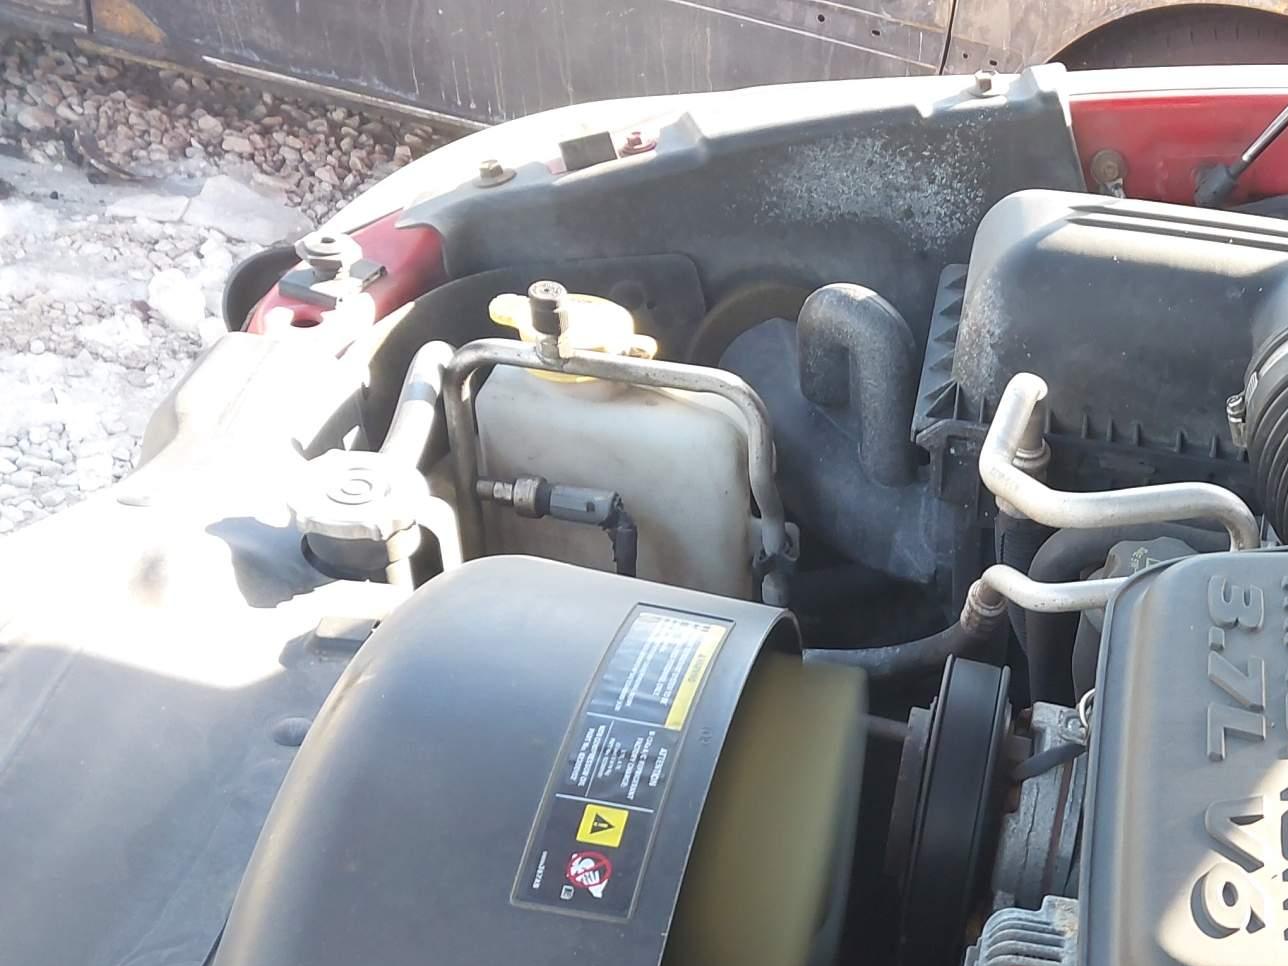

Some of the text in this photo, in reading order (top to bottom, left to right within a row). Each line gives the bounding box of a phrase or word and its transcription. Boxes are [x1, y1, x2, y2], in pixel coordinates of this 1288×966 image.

[648, 747, 668, 787] ATTENTION
[1190, 574, 1266, 939] 3.7L V6
